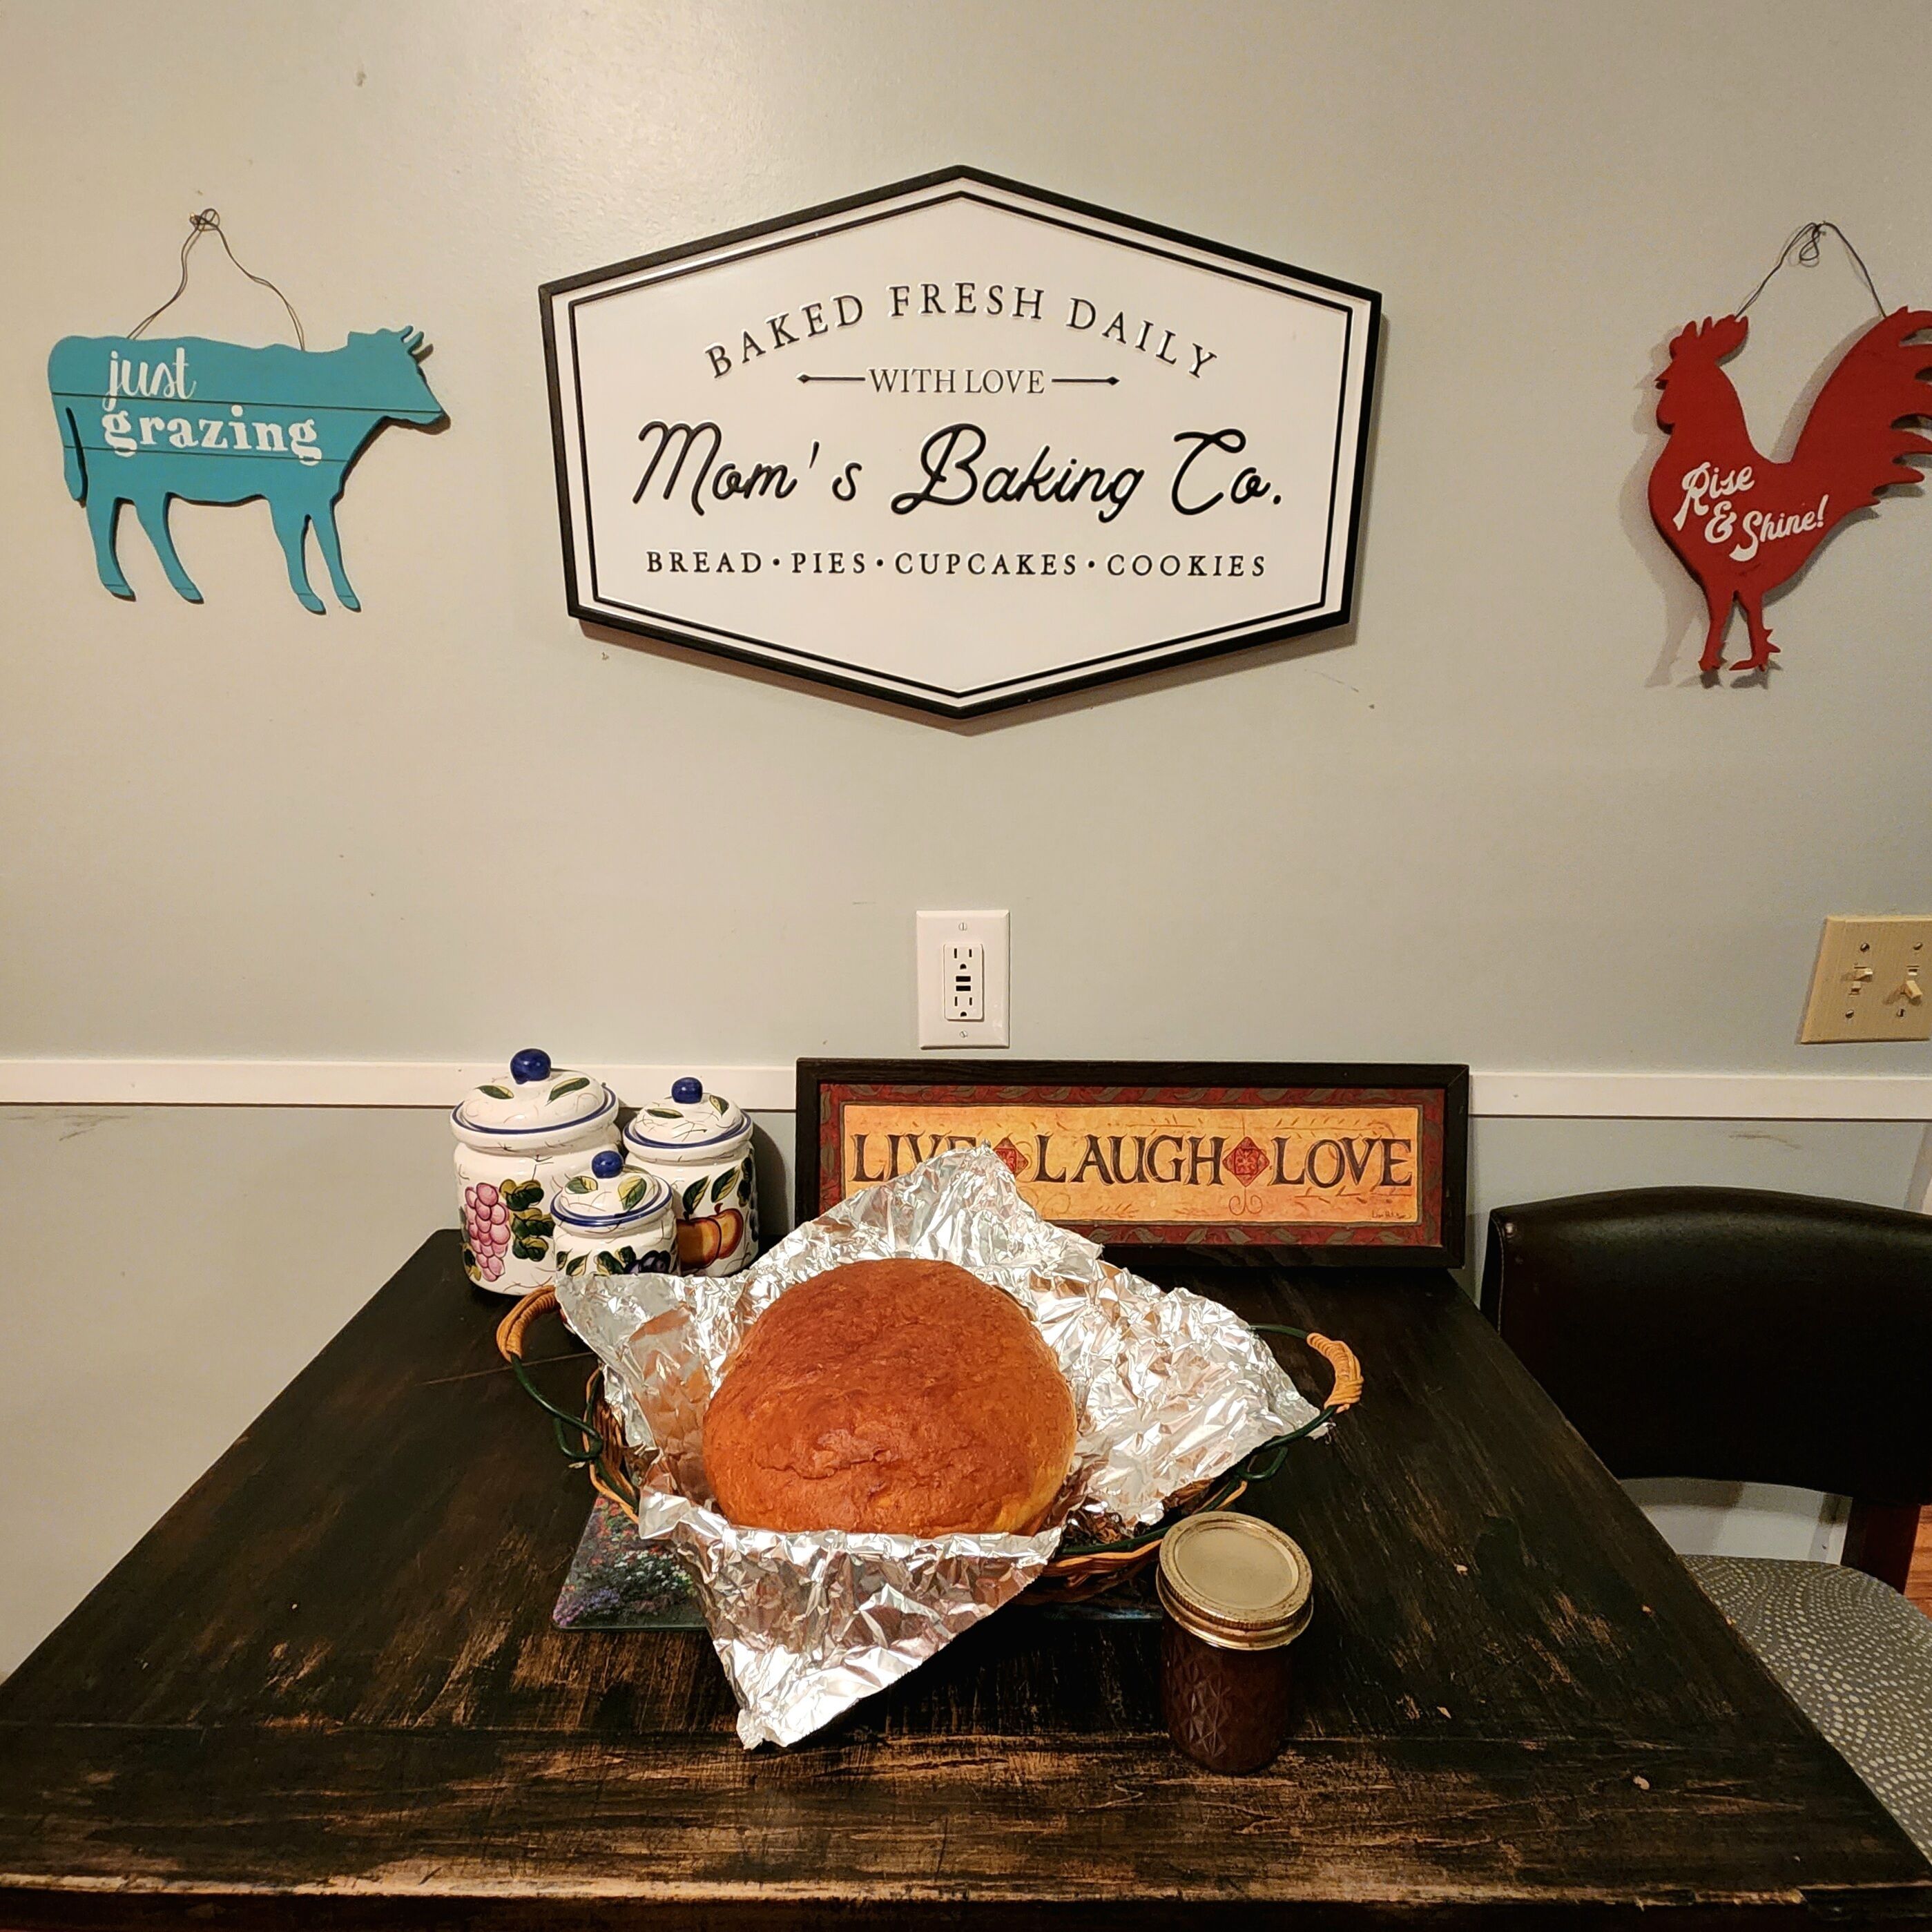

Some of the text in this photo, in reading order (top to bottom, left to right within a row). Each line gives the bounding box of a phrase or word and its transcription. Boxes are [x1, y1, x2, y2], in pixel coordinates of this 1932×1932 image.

[705, 282, 1217, 378] BAKED FRESH DAILY
[102, 347, 197, 412] just
[869, 368, 1045, 394] WITH LOVE
[102, 404, 322, 467] grazing
[631, 420, 1282, 524] Mom's Baking Co.
[1672, 461, 1755, 531] Rise
[1704, 494, 1830, 562] & Shine!
[646, 551, 1265, 577] BREAD PIES CUPCAKES COOKIES
[849, 1131, 1413, 1189] LIV LAUGH LOVE
